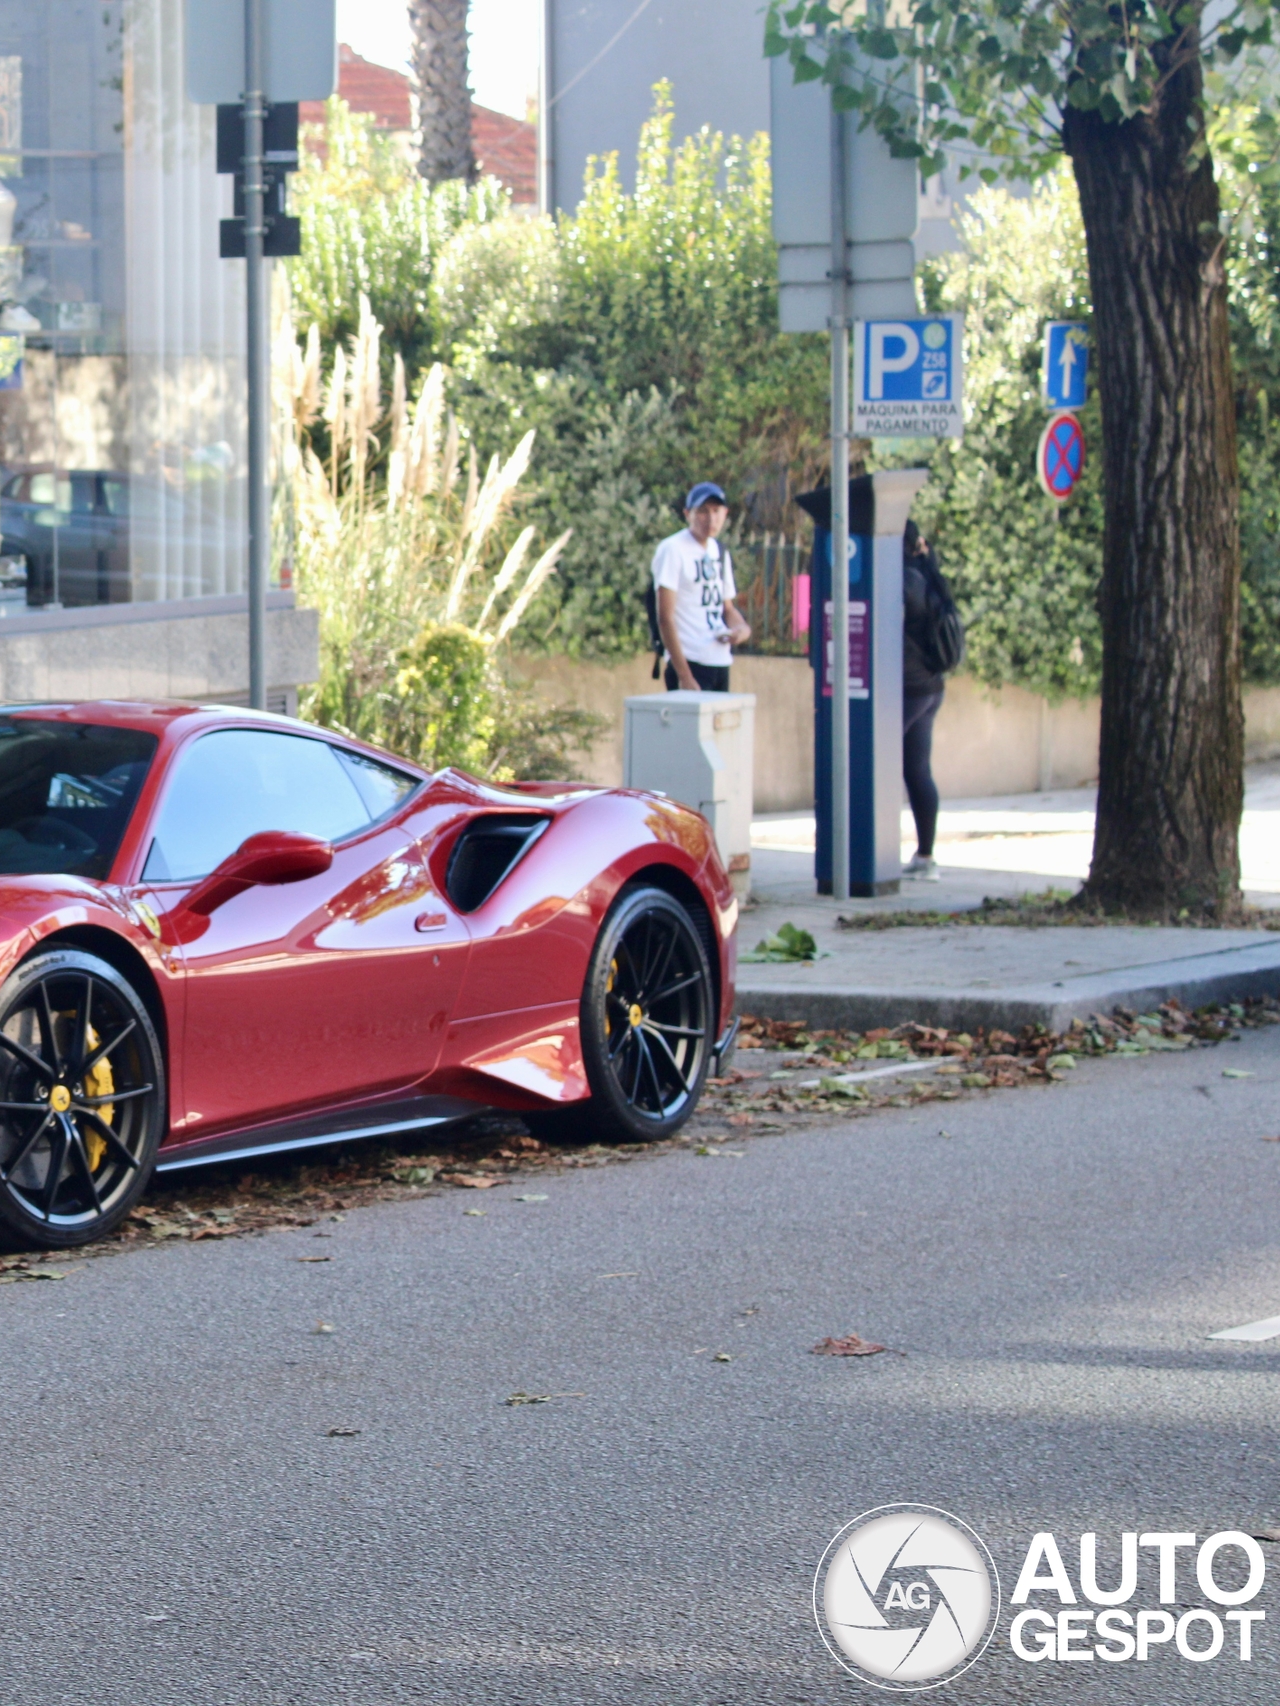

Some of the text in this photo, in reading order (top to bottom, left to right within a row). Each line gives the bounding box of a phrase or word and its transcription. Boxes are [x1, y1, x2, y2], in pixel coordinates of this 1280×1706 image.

[869, 323, 919, 399] P
[922, 403, 958, 415] PARA
[866, 418, 949, 431] PAGAMENTO
